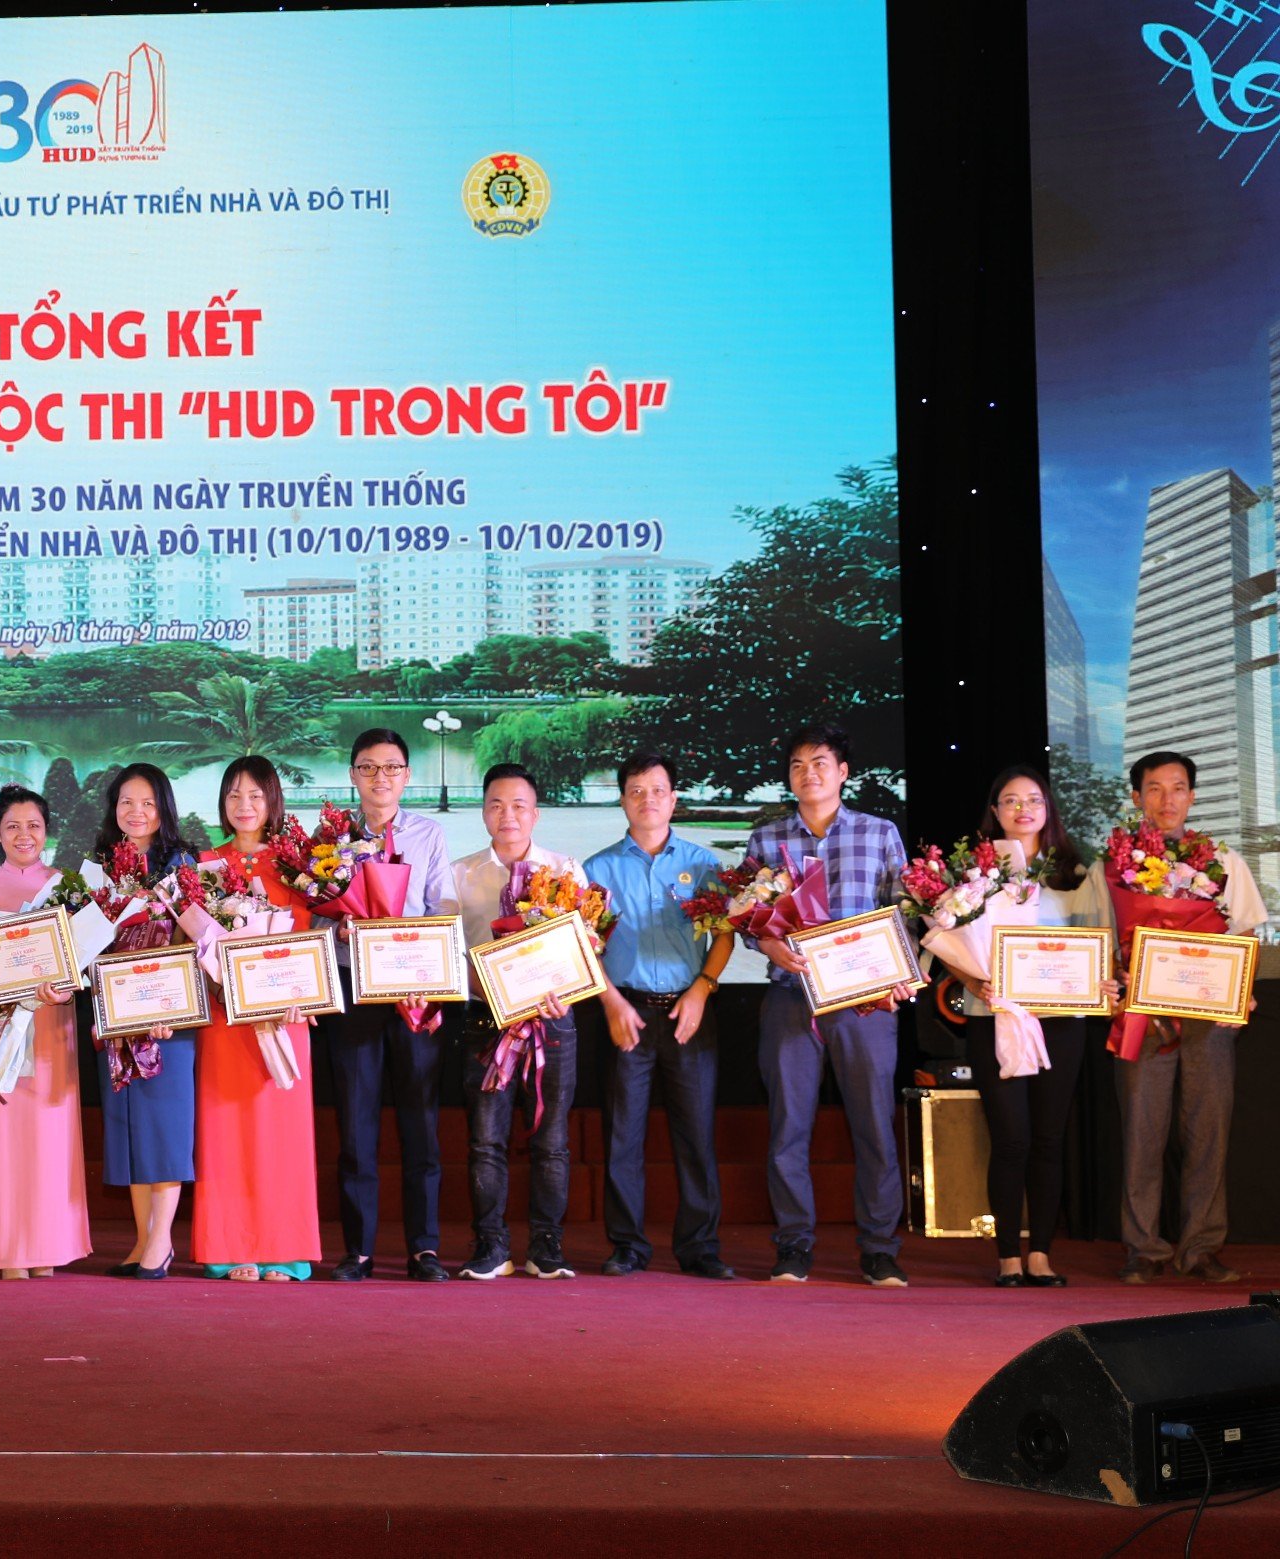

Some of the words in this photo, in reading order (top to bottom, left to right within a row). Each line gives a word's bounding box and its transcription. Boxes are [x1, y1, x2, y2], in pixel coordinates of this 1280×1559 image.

[53, 111, 80, 121] 1989
[66, 125, 94, 134] 2019
[42, 148, 96, 163] HUD
[26, 193, 60, 217] TƯ
[67, 191, 128, 216] PHÁT
[134, 186, 202, 214] TRIỂN
[210, 188, 262, 213] NHÀ
[269, 188, 300, 212] VÀ
[307, 186, 344, 211] ĐÔ
[350, 189, 389, 214] THỊ
[167, 289, 262, 357] KẾT
[80, 393, 163, 440] THI
[331, 386, 526, 436] TRONG
[31, 486, 66, 512] 30
[77, 480, 143, 511] NĂM
[154, 478, 230, 510] NGÀY
[238, 474, 352, 508] TRUYỀN
[363, 471, 466, 506] THỐNG
[41, 526, 102, 557] NHÀ
[111, 524, 149, 556] VÀ
[157, 524, 199, 555] ĐÔ
[208, 528, 257, 562] THỊ
[267, 526, 450, 558] (10/10/1989
[479, 522, 662, 552] 10/10/2019)
[0, 620, 48, 648] ngày
[51, 621, 75, 642] 11
[78, 618, 136, 647] tháng
[138, 620, 152, 641] 9
[155, 618, 198, 641] năm
[200, 618, 251, 641] 2019
